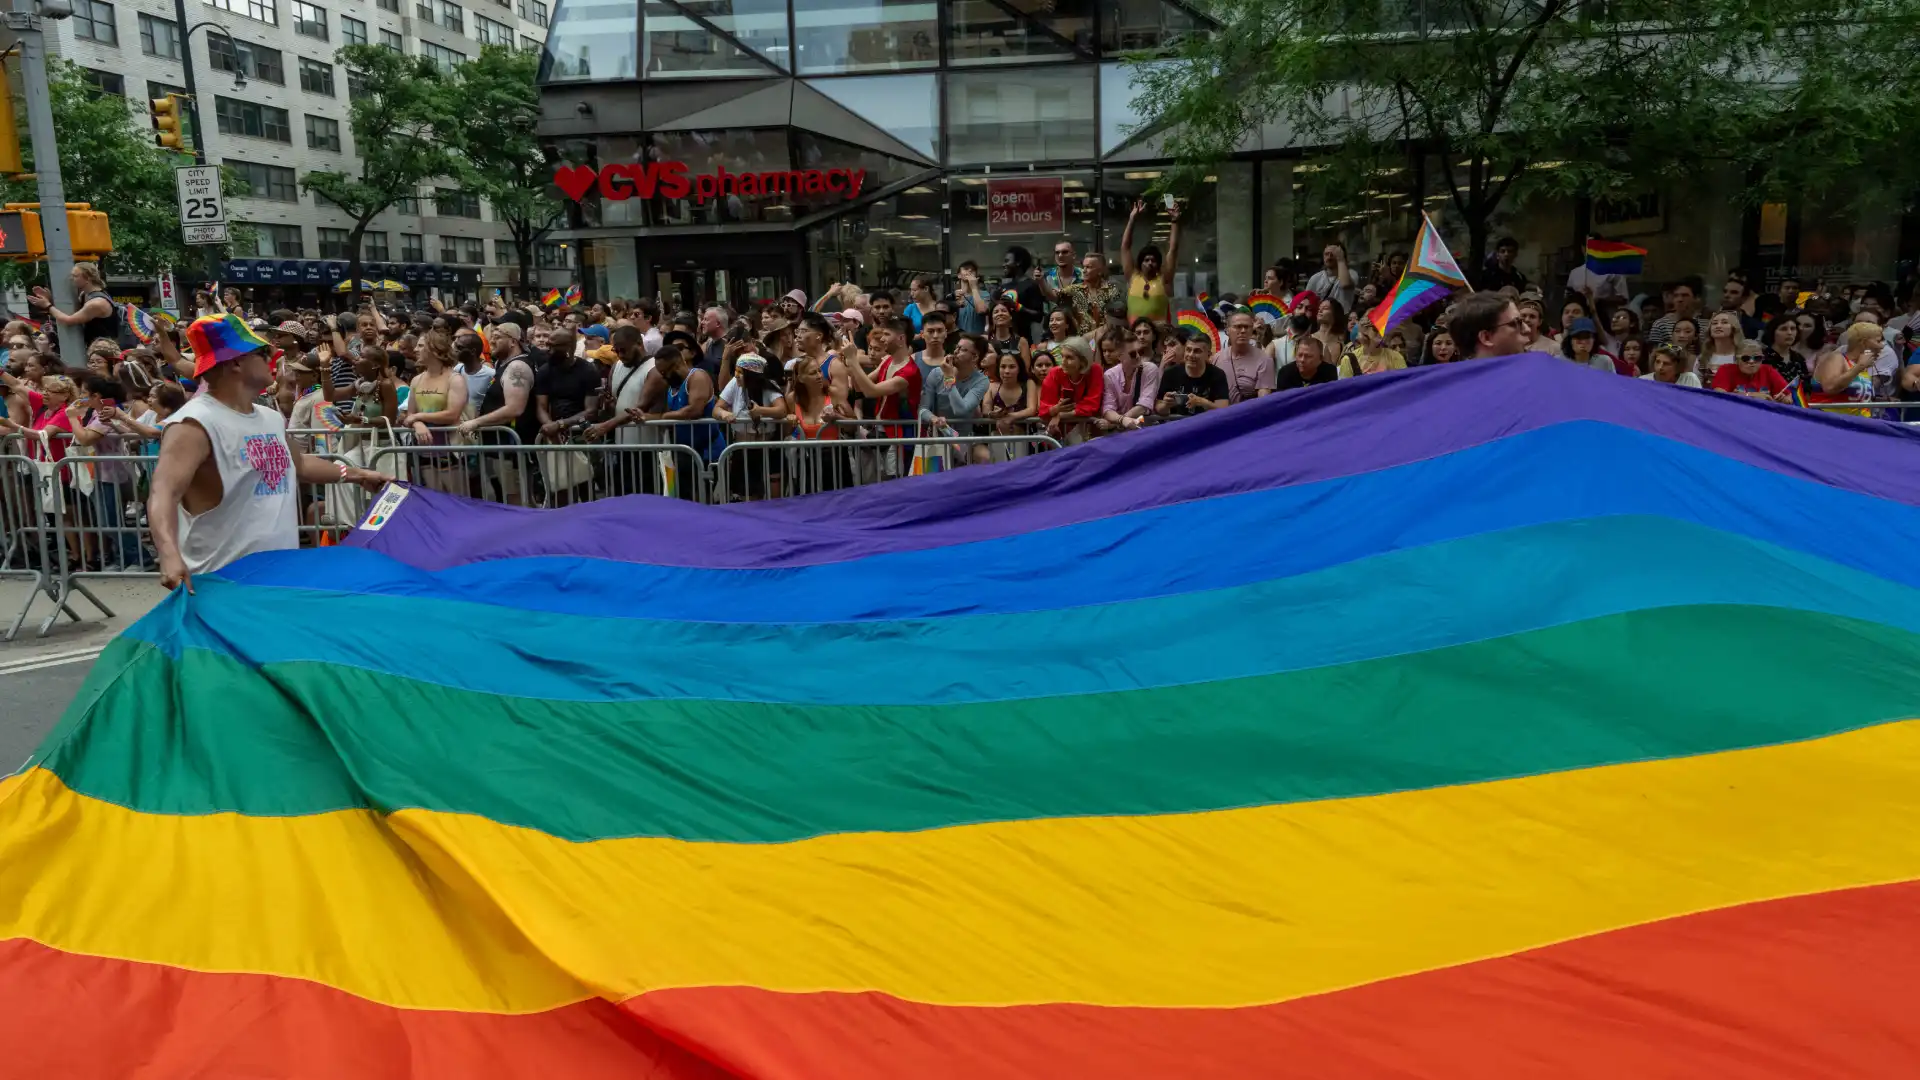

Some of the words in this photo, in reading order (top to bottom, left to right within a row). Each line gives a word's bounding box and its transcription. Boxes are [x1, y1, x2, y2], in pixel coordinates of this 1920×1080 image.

[187, 169, 205, 177] CITY
[185, 178, 211, 186] SPEED
[600, 161, 692, 201] CVS
[697, 164, 867, 205] pharmacy
[188, 187, 209, 195] LIMIT
[991, 191, 1027, 206] open
[185, 197, 219, 219] 25
[991, 210, 1009, 223] 24
[1012, 209, 1053, 222] hours
